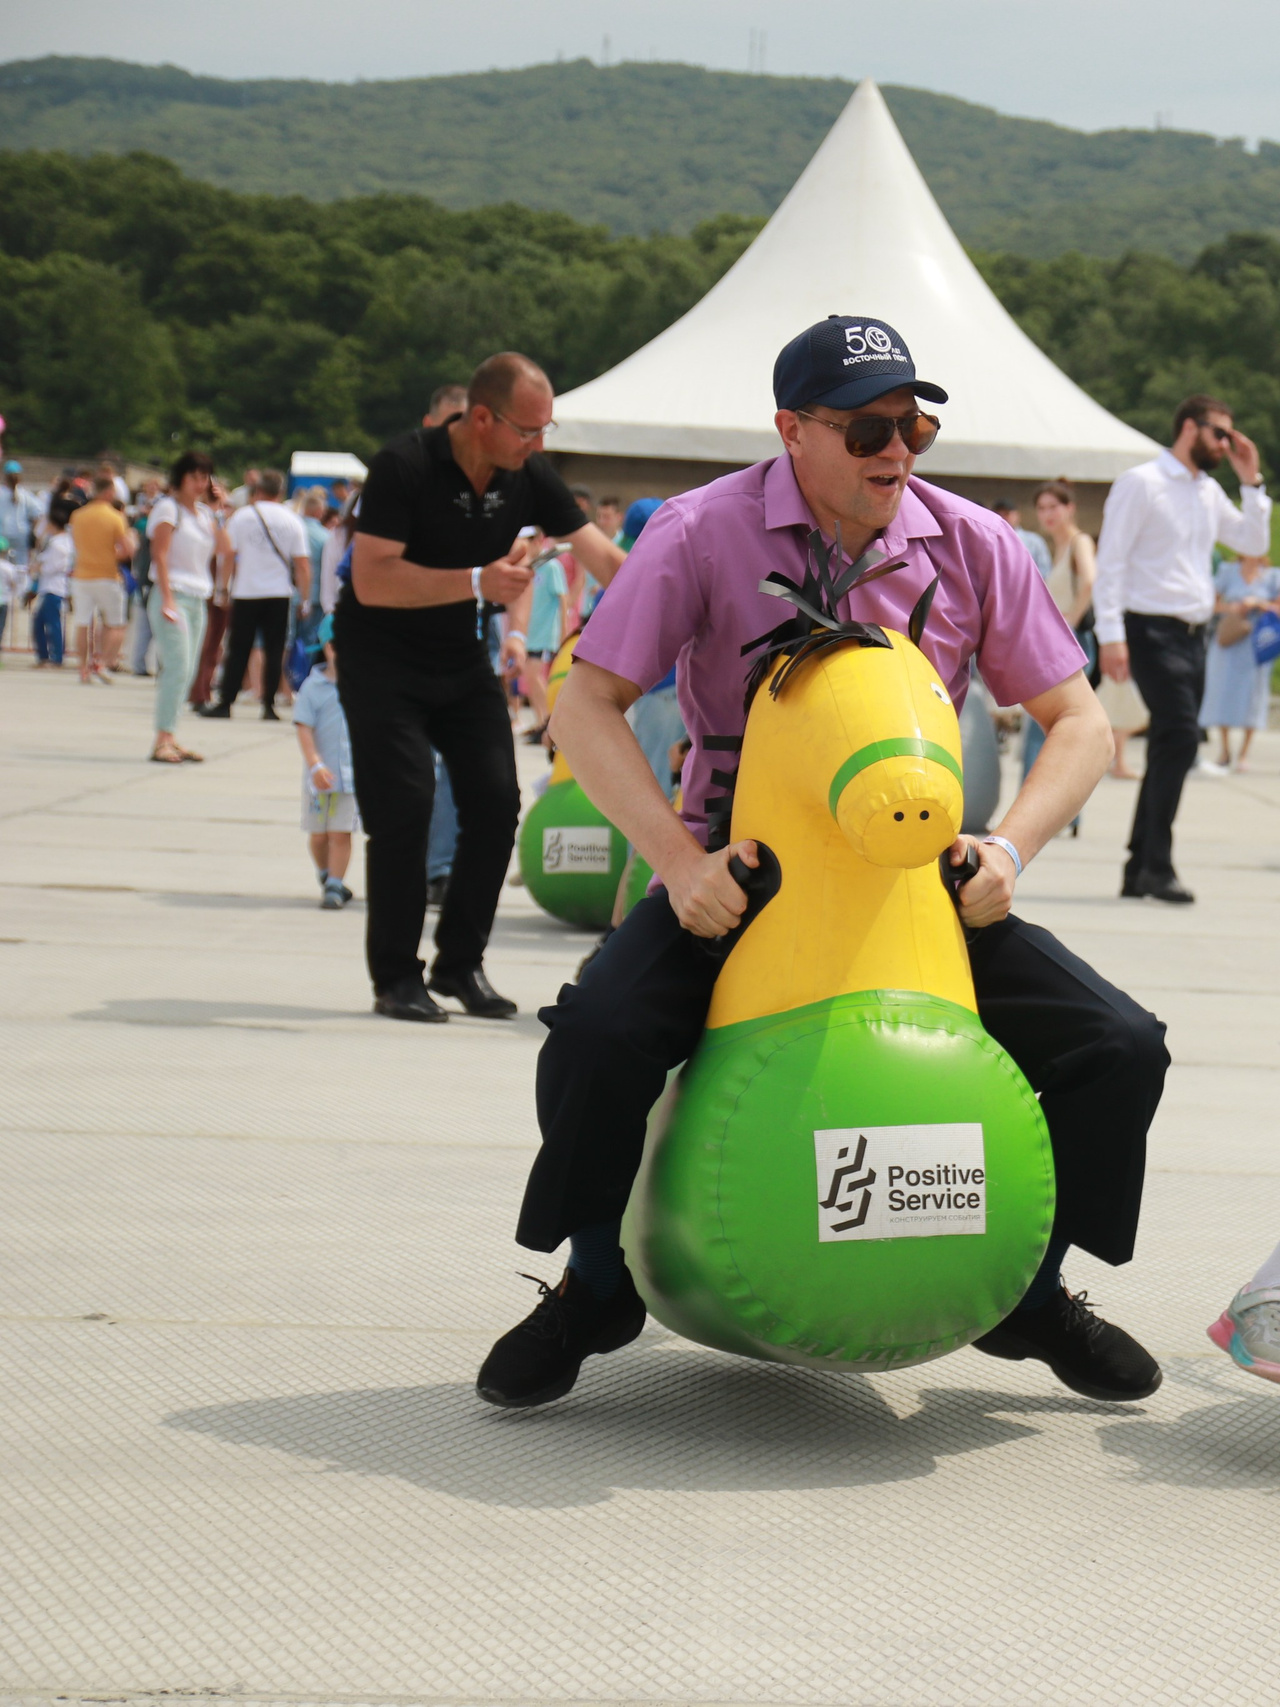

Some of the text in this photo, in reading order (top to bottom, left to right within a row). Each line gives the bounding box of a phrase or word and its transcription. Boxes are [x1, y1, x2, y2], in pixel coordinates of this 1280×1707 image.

[844, 326, 892, 354] 50
[842, 352, 892, 366] ВОСТОЧНЫЙ
[888, 1164, 985, 1187] Positive
[888, 1188, 980, 1212] Service
